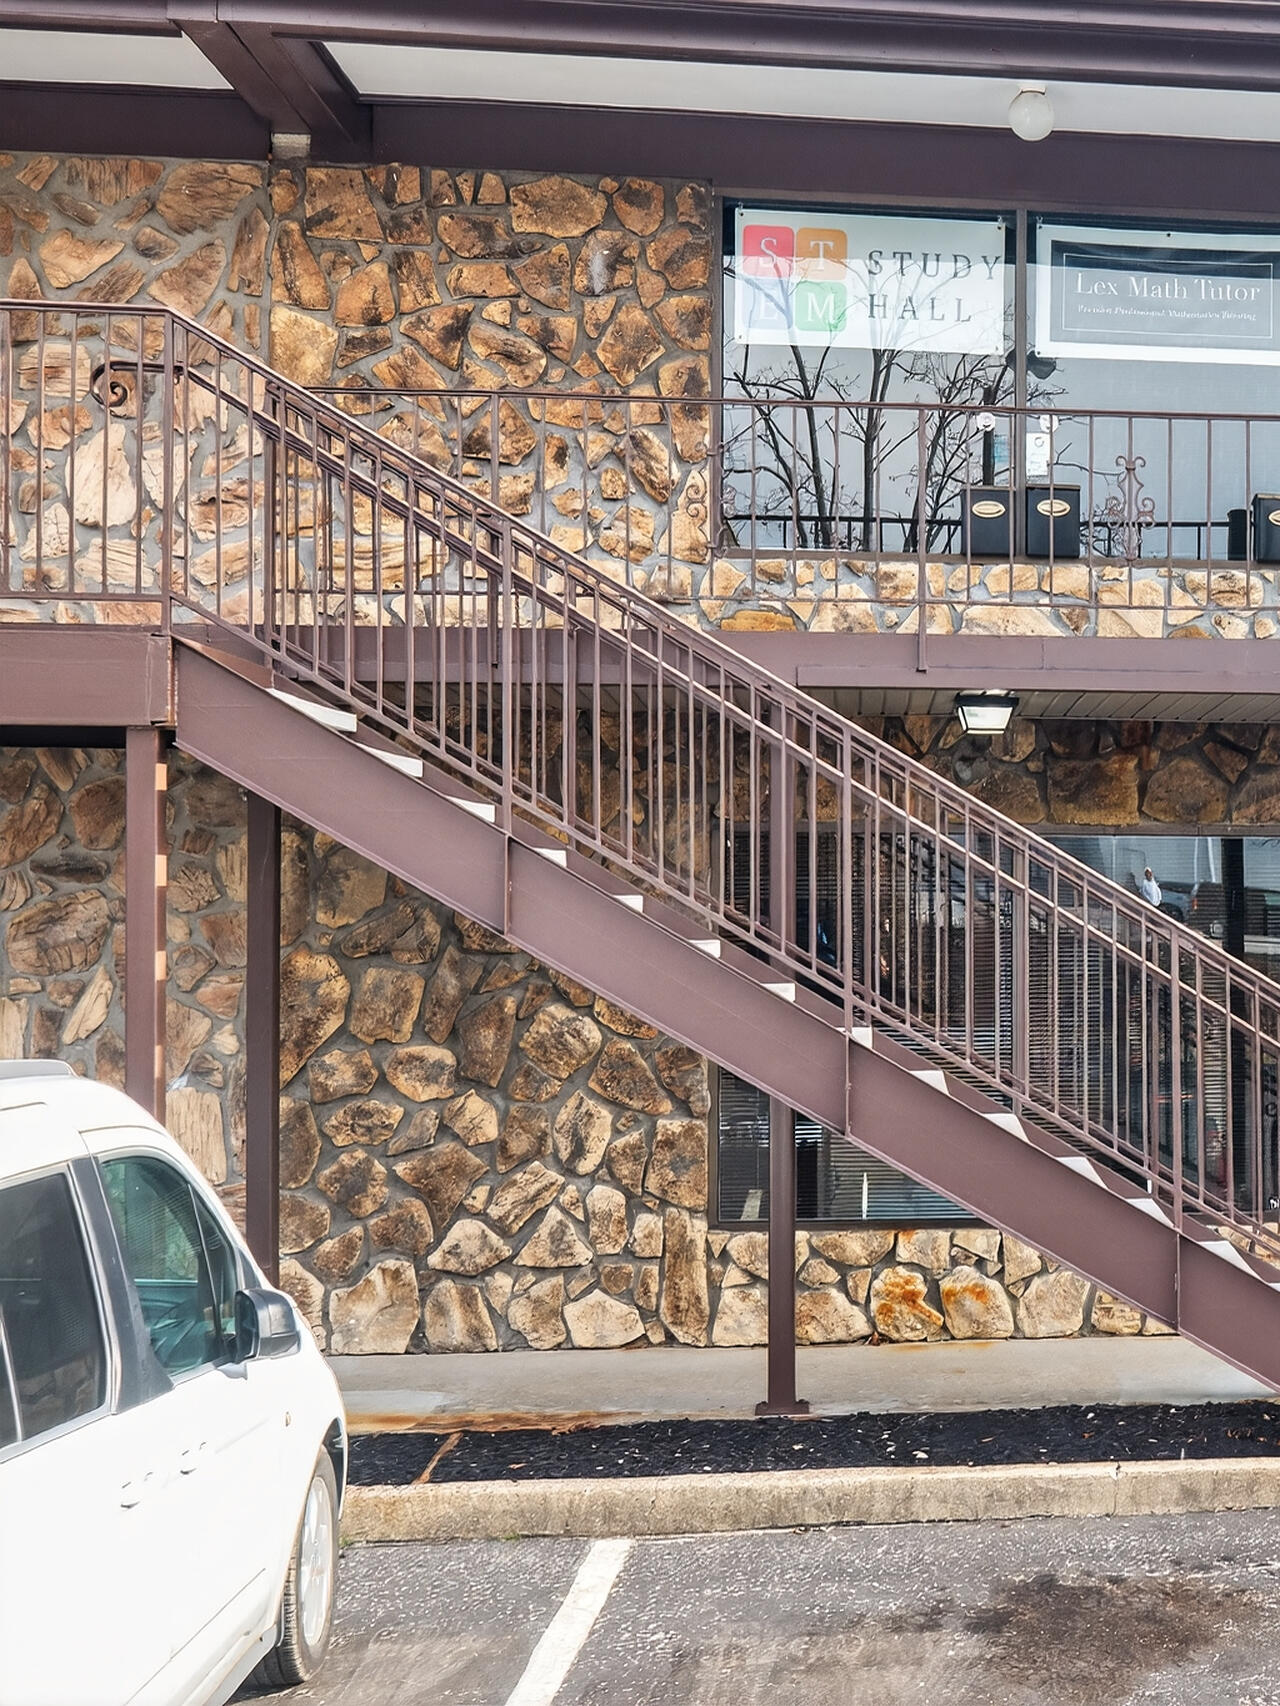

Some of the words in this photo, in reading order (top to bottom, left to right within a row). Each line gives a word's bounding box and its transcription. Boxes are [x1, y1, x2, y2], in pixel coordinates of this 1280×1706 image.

[868, 250, 1002, 280] STUDY
[1075, 272, 1119, 296] Lex
[1128, 275, 1189, 299] Math
[1193, 278, 1261, 301] Tutor
[868, 294, 972, 322] HALL
